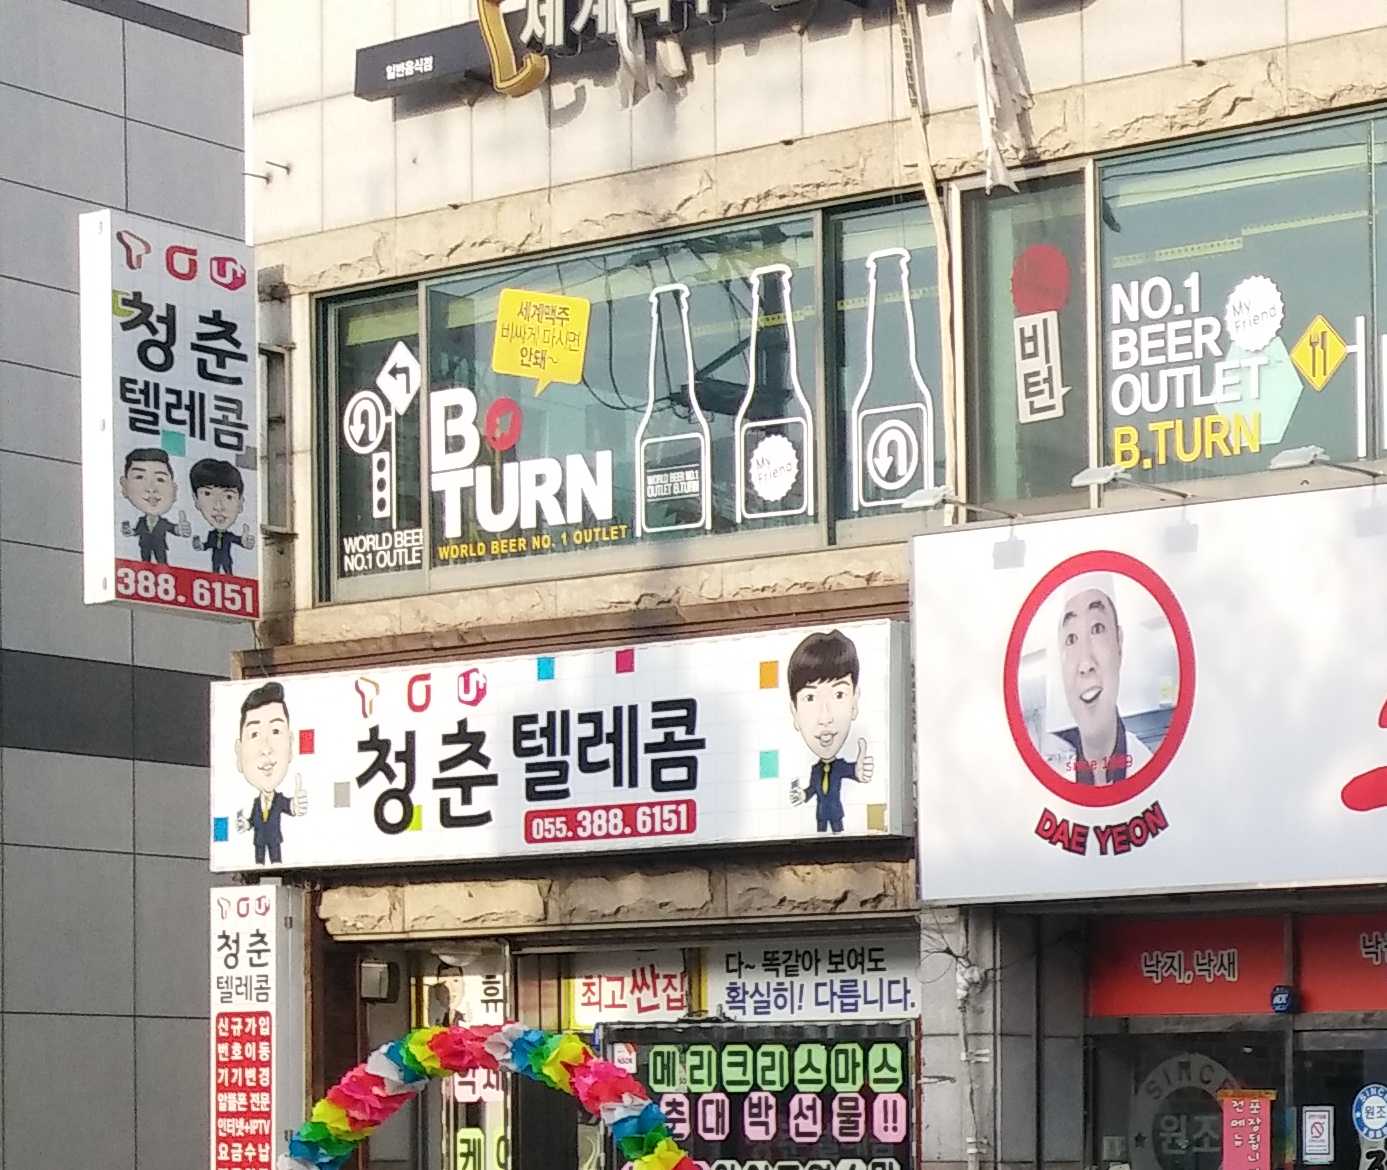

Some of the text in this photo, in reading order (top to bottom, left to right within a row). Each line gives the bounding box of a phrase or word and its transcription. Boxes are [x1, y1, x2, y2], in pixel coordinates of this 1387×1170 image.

[517, 301, 570, 327] 세계맥주
[1111, 272, 1200, 324] NO.1
[1232, 299, 1252, 319] My
[1234, 306, 1278, 333] Friend
[120, 291, 249, 386] 청춘
[500, 322, 581, 353] 비싸게 마시면
[1111, 316, 1222, 370] BEER
[1019, 317, 1056, 417] 비턴
[1111, 357, 1269, 417] OUTLET
[119, 376, 249, 452] 텔레콤
[429, 387, 480, 473] B
[1113, 411, 1262, 470] B.TURN
[430, 450, 613, 539] TURN
[343, 532, 392, 552] WORLD
[439, 525, 628, 561] WORLD BEER OUTLET
[344, 553, 375, 572] NO.1
[194, 580, 254, 614] 6151
[356, 697, 707, 836] 청춘 텔레콤
[636, 804, 688, 833] 6151
[1034, 800, 1170, 857] DAE YEON
[217, 929, 271, 969] 청춘
[762, 947, 887, 977] 똑같아 보여도
[216, 975, 271, 1004] 텔레콤
[725, 977, 915, 1015] 확실히! 다릅니다.
[217, 1017, 271, 1037] 신규가입
[217, 1042, 271, 1062] 번호이동
[652, 1046, 901, 1089] 메리크리스마스
[217, 1067, 271, 1087] 기기변경
[1364, 1103, 1387, 1121] 원조
[217, 1143, 271, 1163] 요금수납
